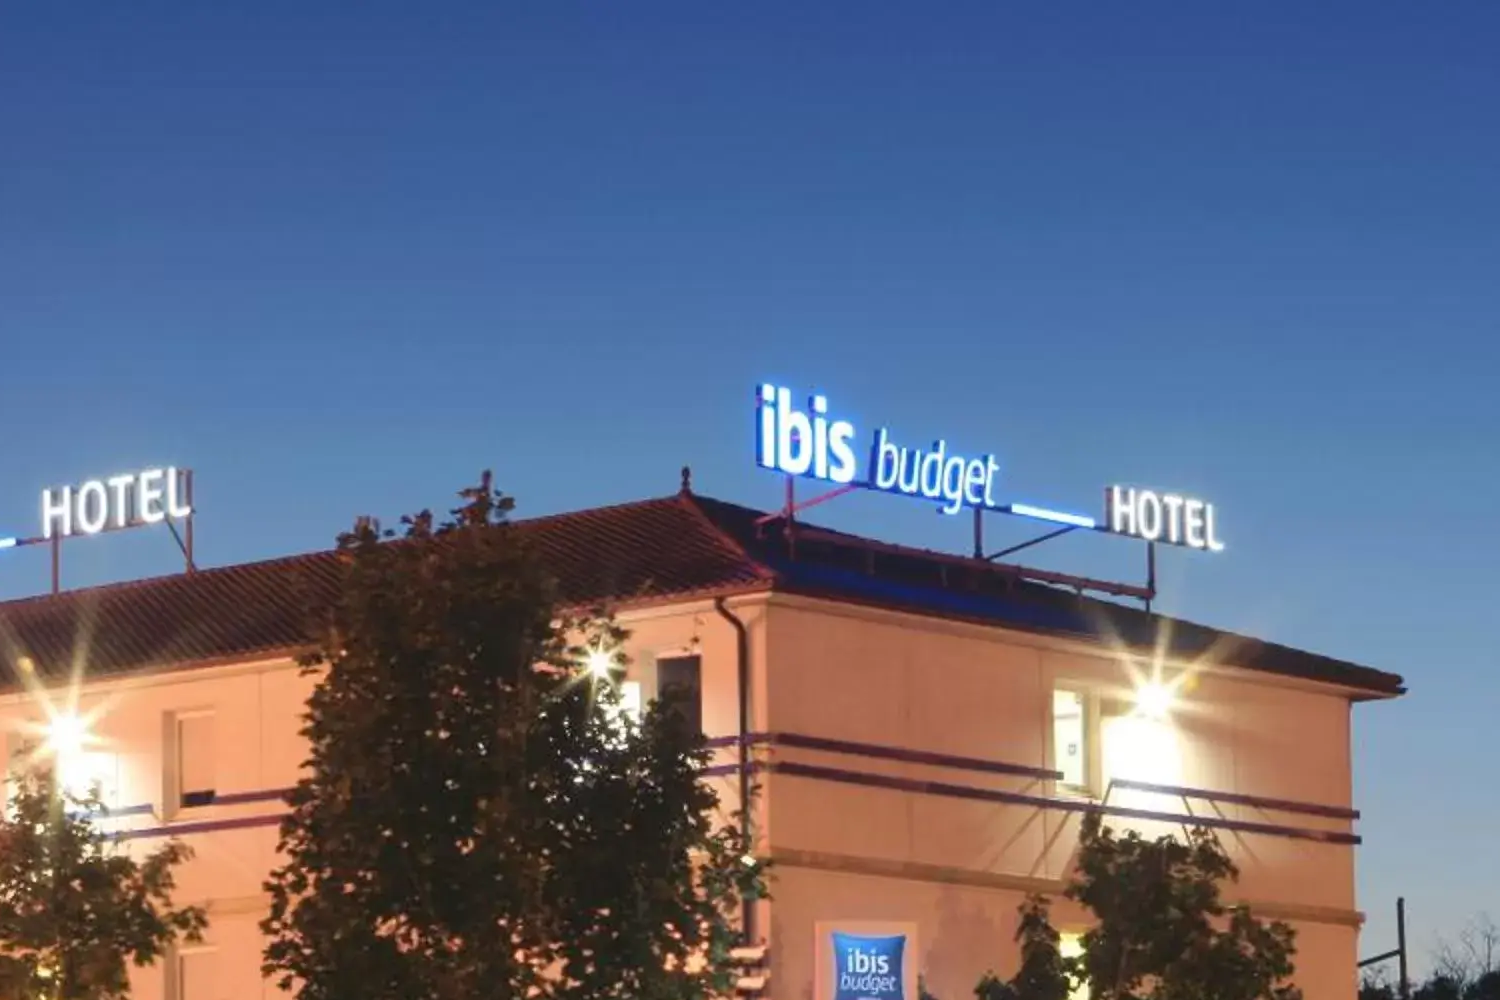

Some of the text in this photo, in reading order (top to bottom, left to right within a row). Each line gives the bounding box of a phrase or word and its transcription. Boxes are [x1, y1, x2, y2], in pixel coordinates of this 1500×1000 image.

[760, 383, 1000, 516] ibis budget
[41, 466, 193, 538] HOTEL
[1111, 484, 1225, 552] HOTEL
[840, 971, 897, 995] budget
[846, 947, 890, 974] ibis
